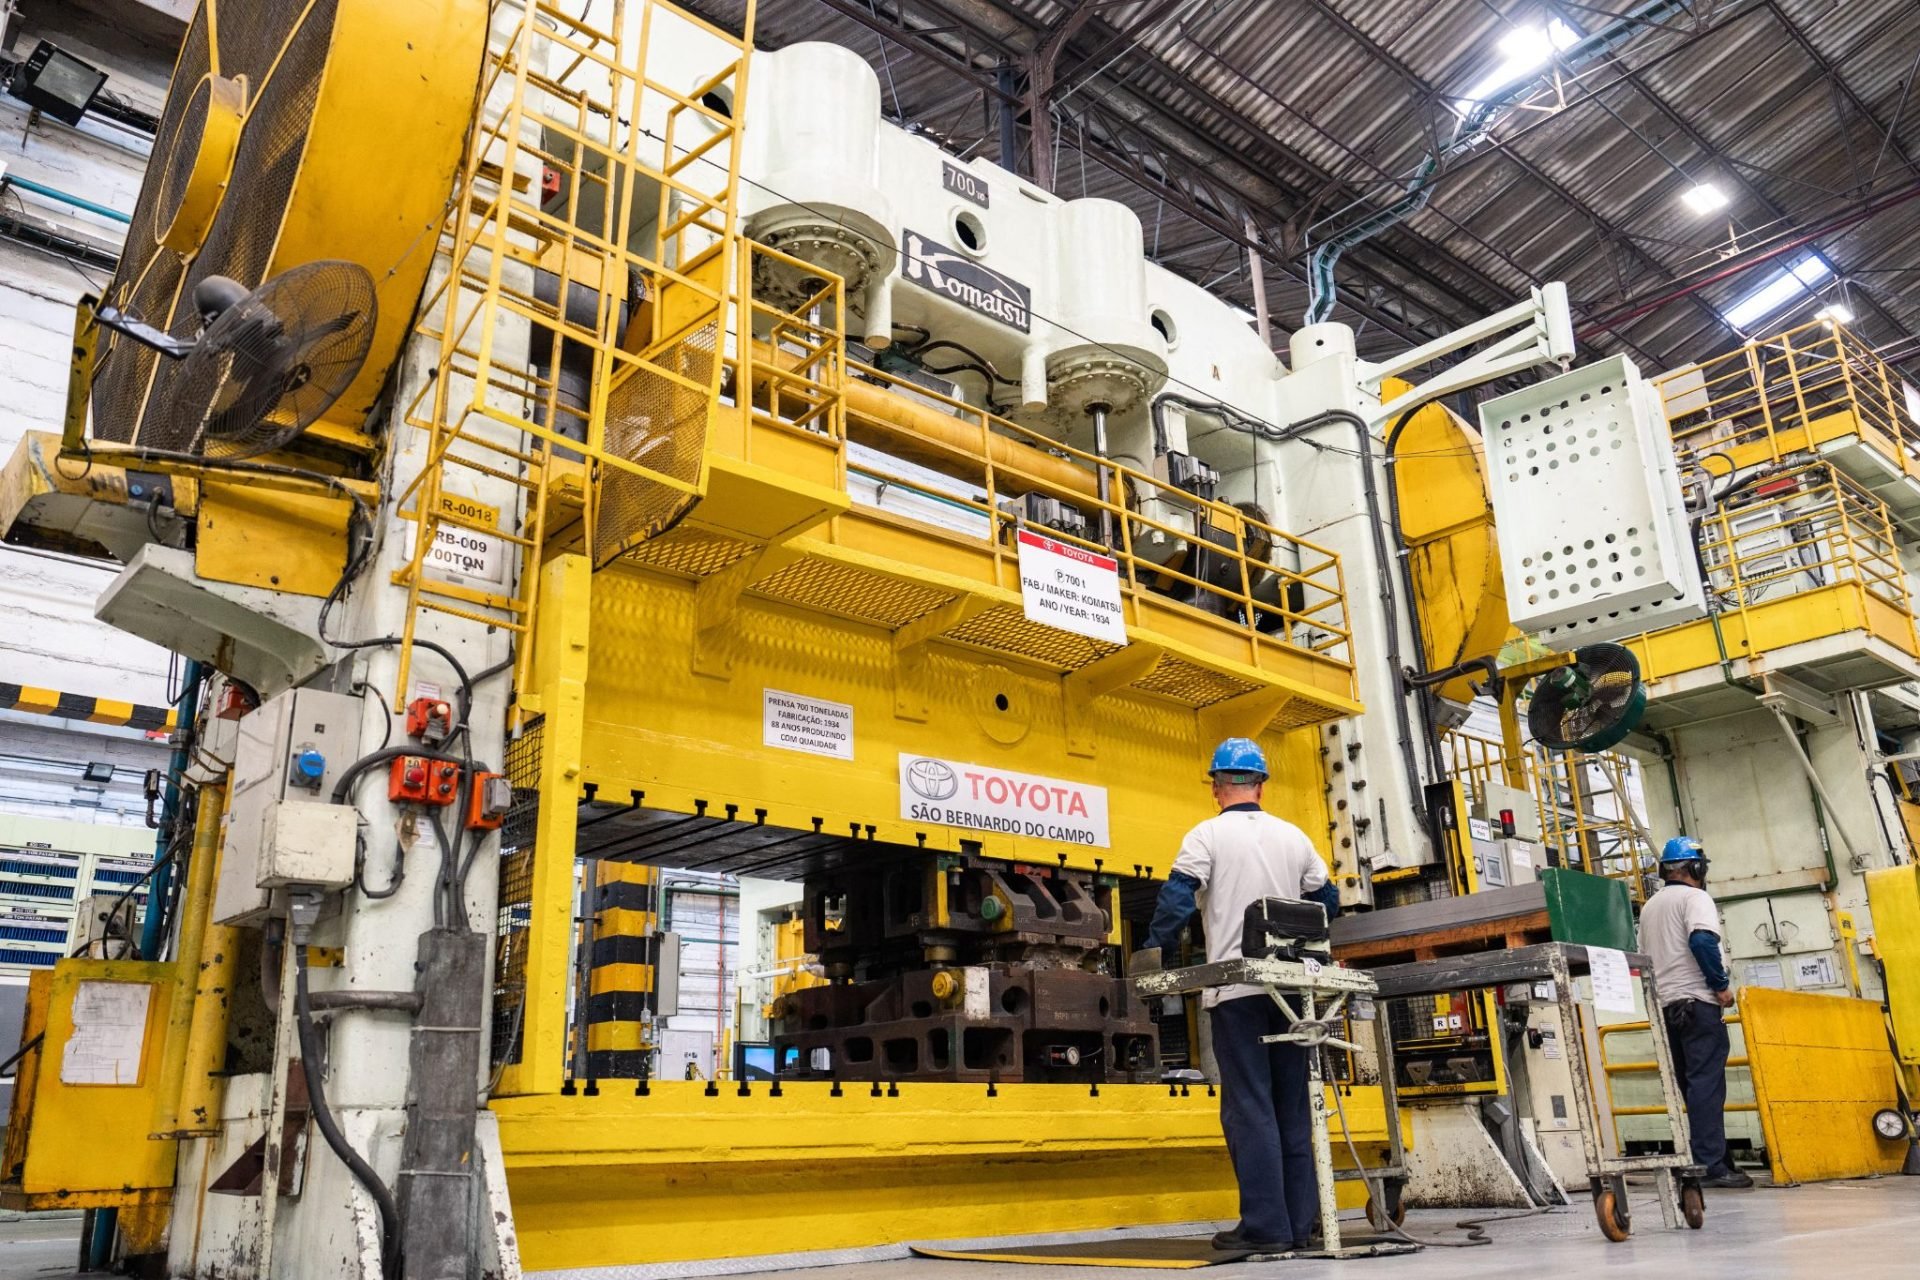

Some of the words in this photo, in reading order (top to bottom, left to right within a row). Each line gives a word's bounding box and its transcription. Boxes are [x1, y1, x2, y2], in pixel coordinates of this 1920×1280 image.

[947, 167, 976, 196] 700
[907, 234, 1028, 328] Komatsu
[442, 498, 493, 522] R-0018
[1061, 547, 1095, 564] TOYOTA
[1065, 575, 1080, 587] 700
[1046, 584, 1080, 602] MAKER:
[1082, 594, 1121, 614] KOMATSU
[1039, 598, 1058, 611] ANO
[1092, 613, 1110, 625] 1934
[768, 697, 795, 709] PRENSA
[797, 703, 808, 711] 700
[810, 705, 849, 719] TONELADAS
[778, 710, 823, 725] FABRICAÇÃO:
[824, 720, 840, 728] 1934
[771, 721, 779, 729] 88
[781, 722, 801, 732] ANOS
[802, 727, 846, 741] PRODUZINDO
[780, 734, 798, 743] COM
[799, 737, 837, 750] QUALIDADE
[964, 772, 1089, 819] TOYOTA
[911, 803, 942, 822] SÃO
[946, 809, 1021, 833] BERNARDO
[1025, 822, 1045, 837] DO
[1049, 826, 1095, 845] CAMPO
